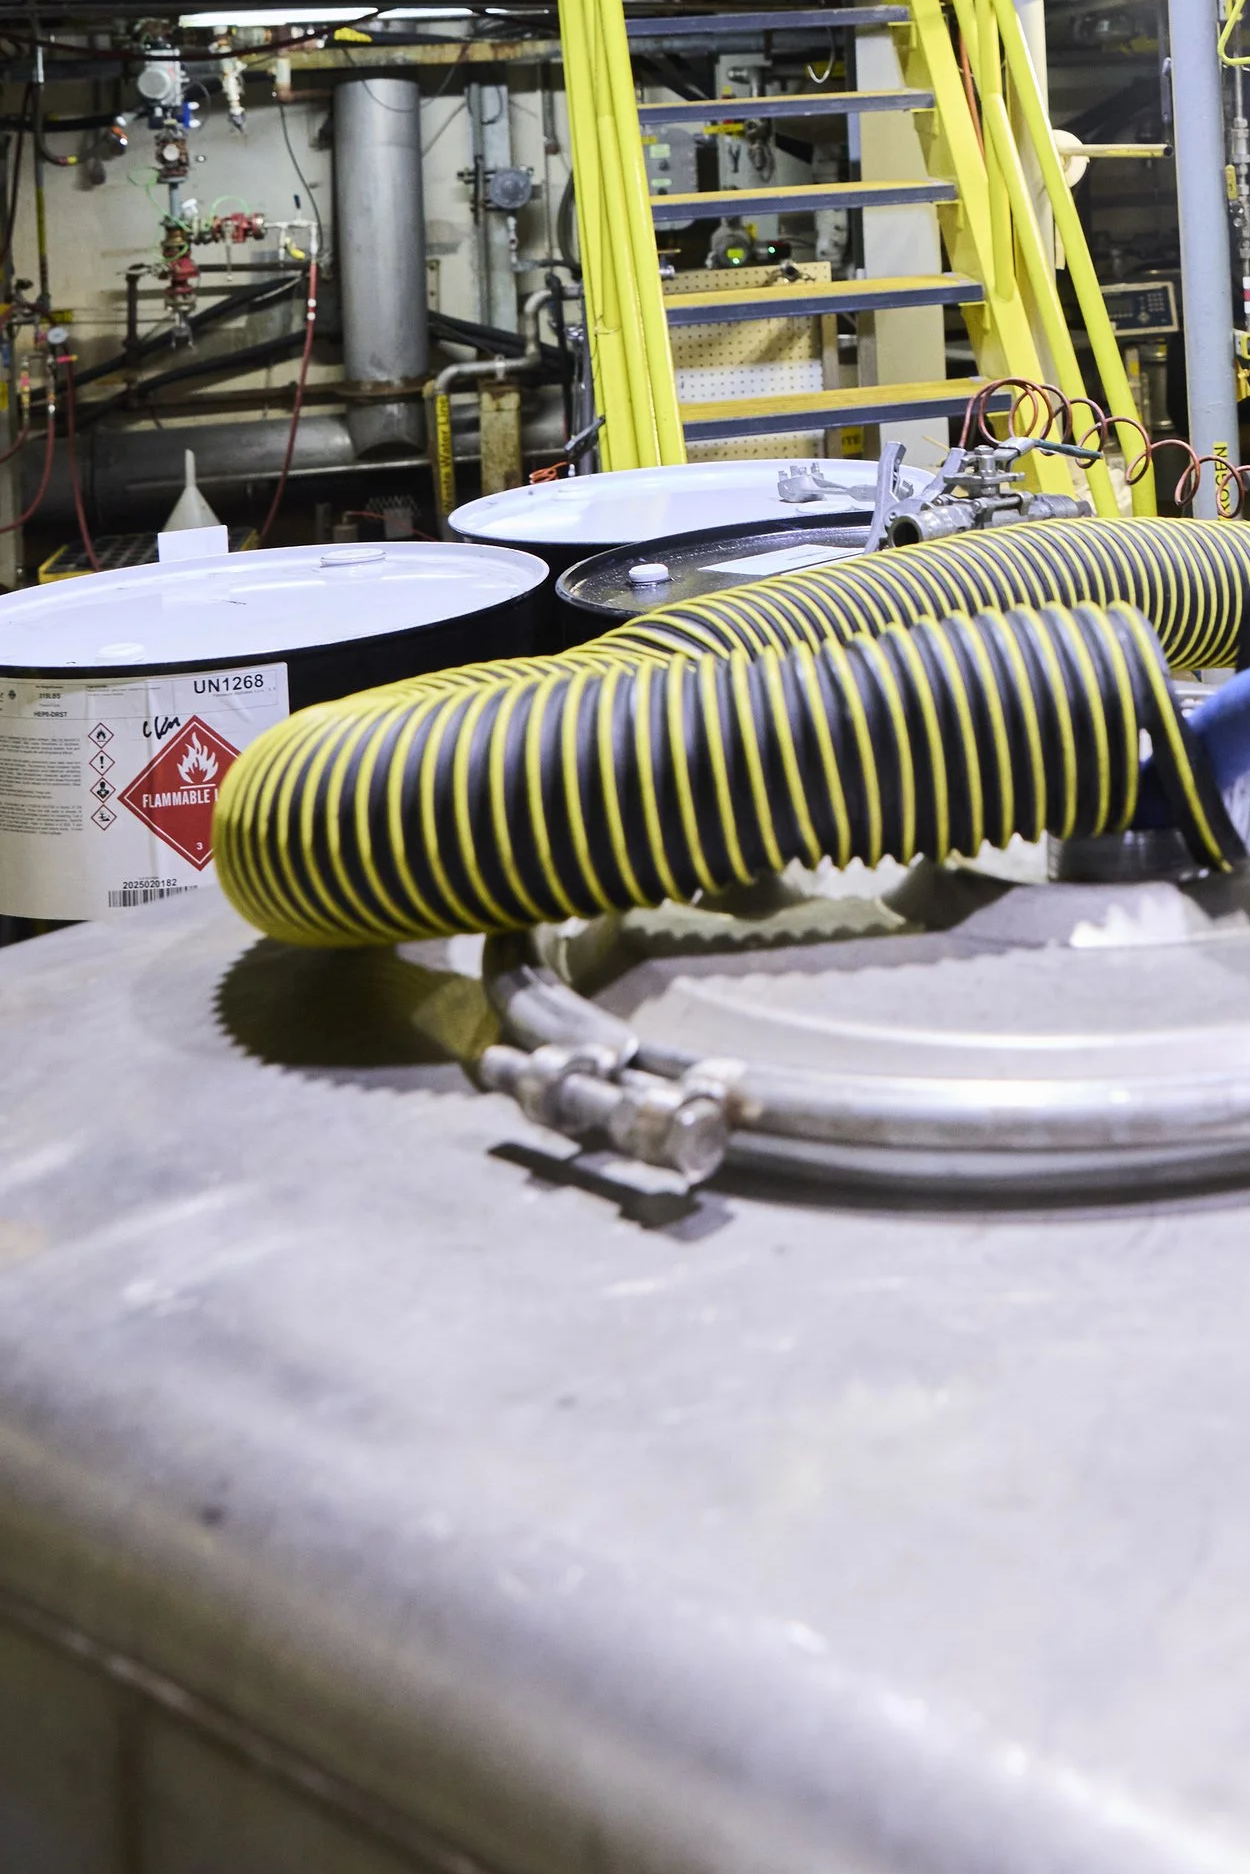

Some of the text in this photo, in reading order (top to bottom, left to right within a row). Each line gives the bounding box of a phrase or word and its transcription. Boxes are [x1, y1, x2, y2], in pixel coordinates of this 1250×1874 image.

[194, 674, 264, 694] UN1268
[142, 789, 211, 808] FLAMMABLE
[196, 842, 203, 851] 3
[122, 878, 178, 889] 2025020182
